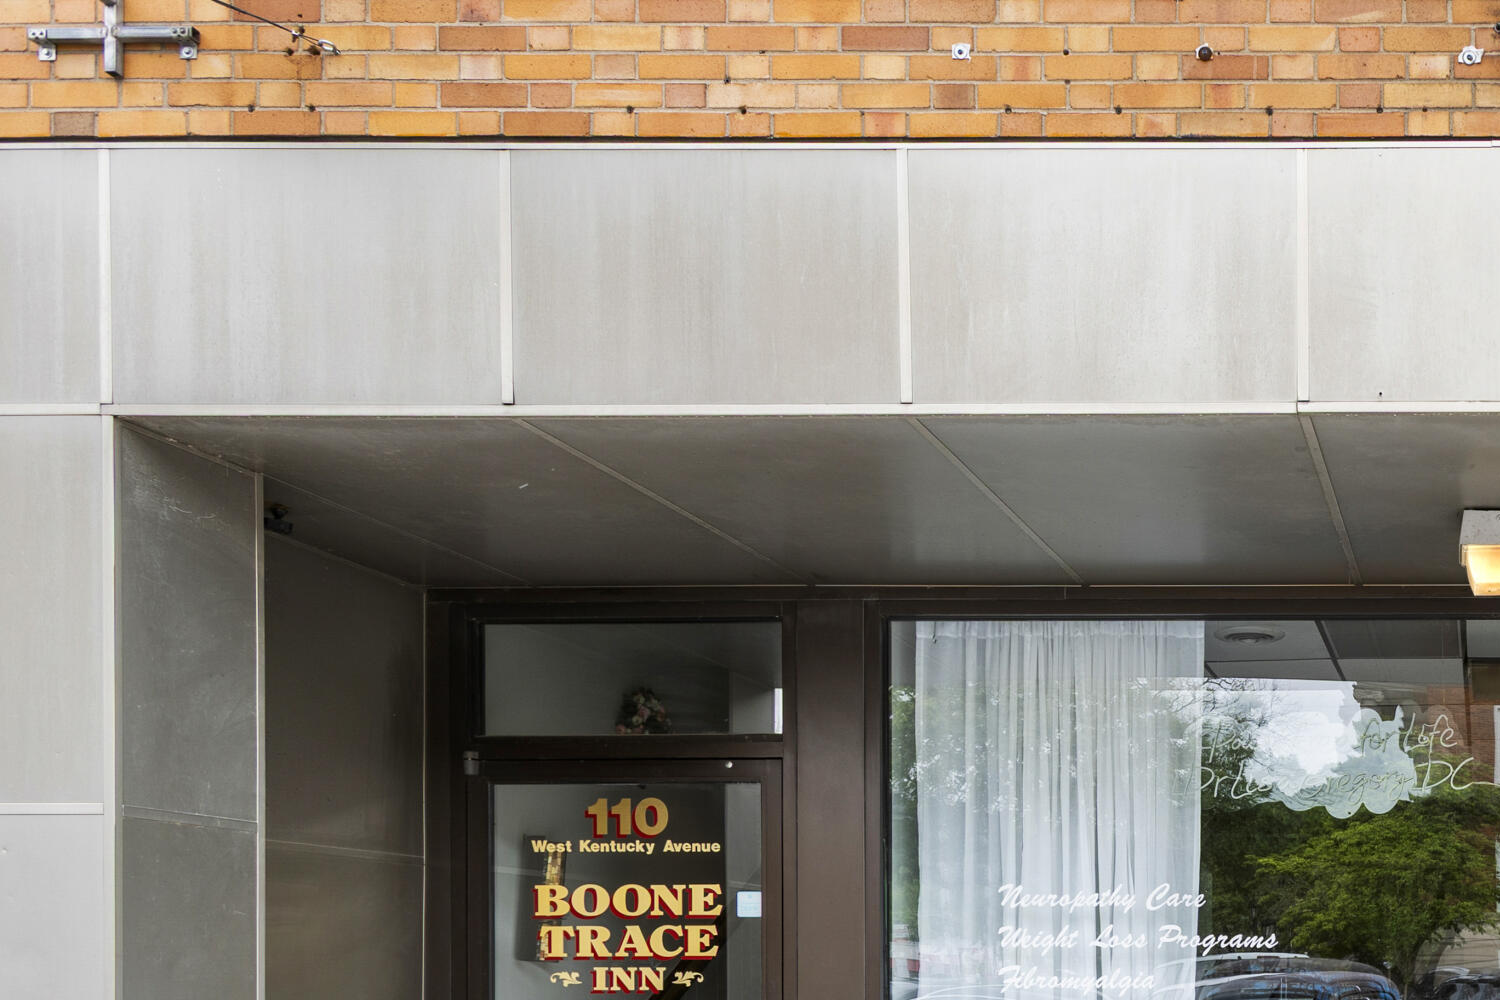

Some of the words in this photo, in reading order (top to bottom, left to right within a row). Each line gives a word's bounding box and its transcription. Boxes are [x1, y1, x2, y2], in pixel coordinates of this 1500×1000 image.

[585, 797, 669, 839] 110
[531, 840, 572, 853] West
[579, 840, 655, 855] Kentucky
[663, 840, 721, 853] Avenue
[532, 884, 724, 919] BOONE
[998, 883, 1137, 913] Neuropathy
[1146, 883, 1207, 911] Care
[539, 924, 719, 960] TRACE
[998, 925, 1079, 949] Weight
[1089, 924, 1148, 950] Loss
[1158, 924, 1279, 956] Programs
[591, 966, 666, 994] INN
[998, 965, 1155, 997] Fibromyalgia
